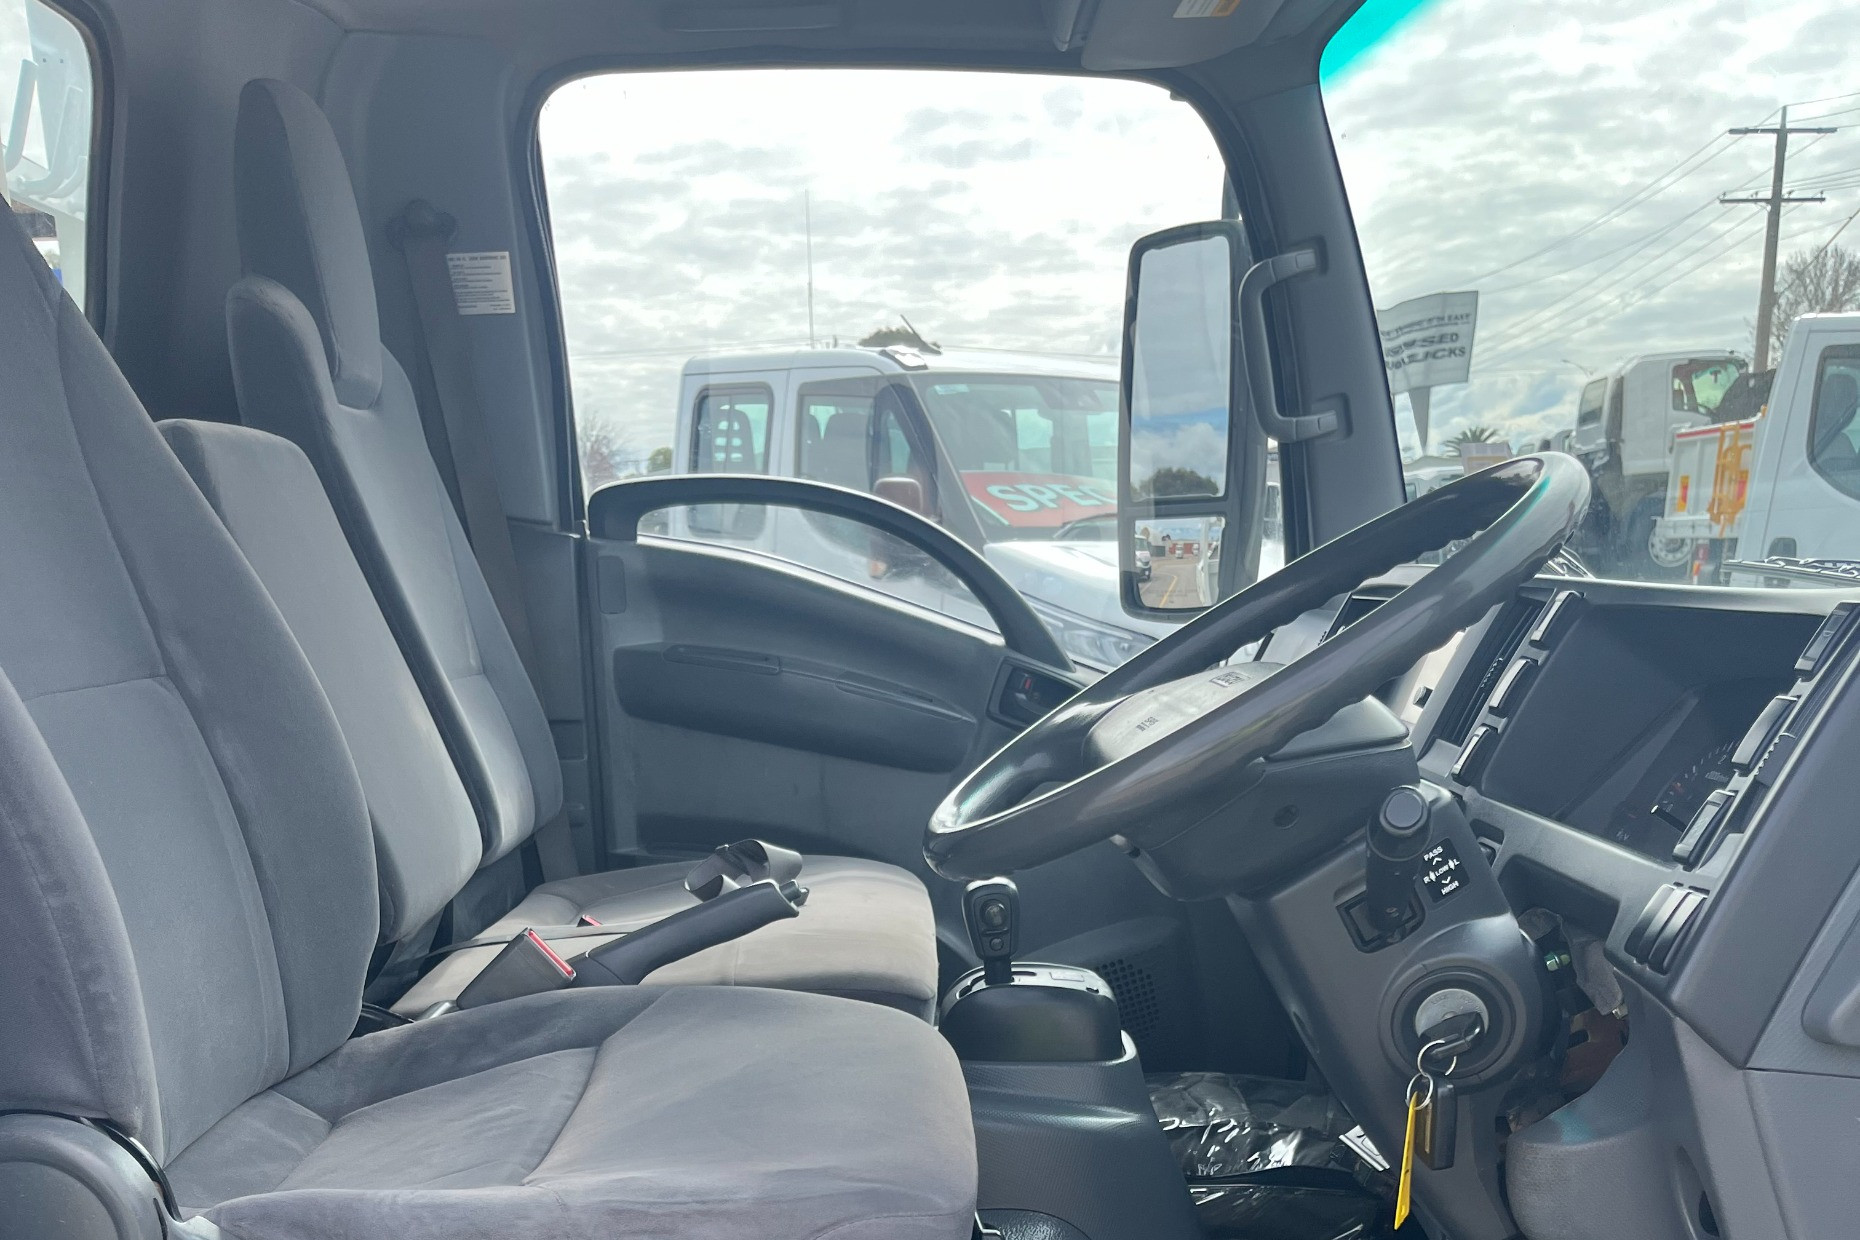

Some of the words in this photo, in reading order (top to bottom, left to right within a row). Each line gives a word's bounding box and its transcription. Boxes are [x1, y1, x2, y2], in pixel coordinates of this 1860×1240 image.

[1423, 845, 1444, 862] PASS
[1423, 876, 1431, 884] R
[1434, 864, 1449, 877] LOW
[1452, 858, 1460, 866] L
[1441, 880, 1460, 896] HIGH
